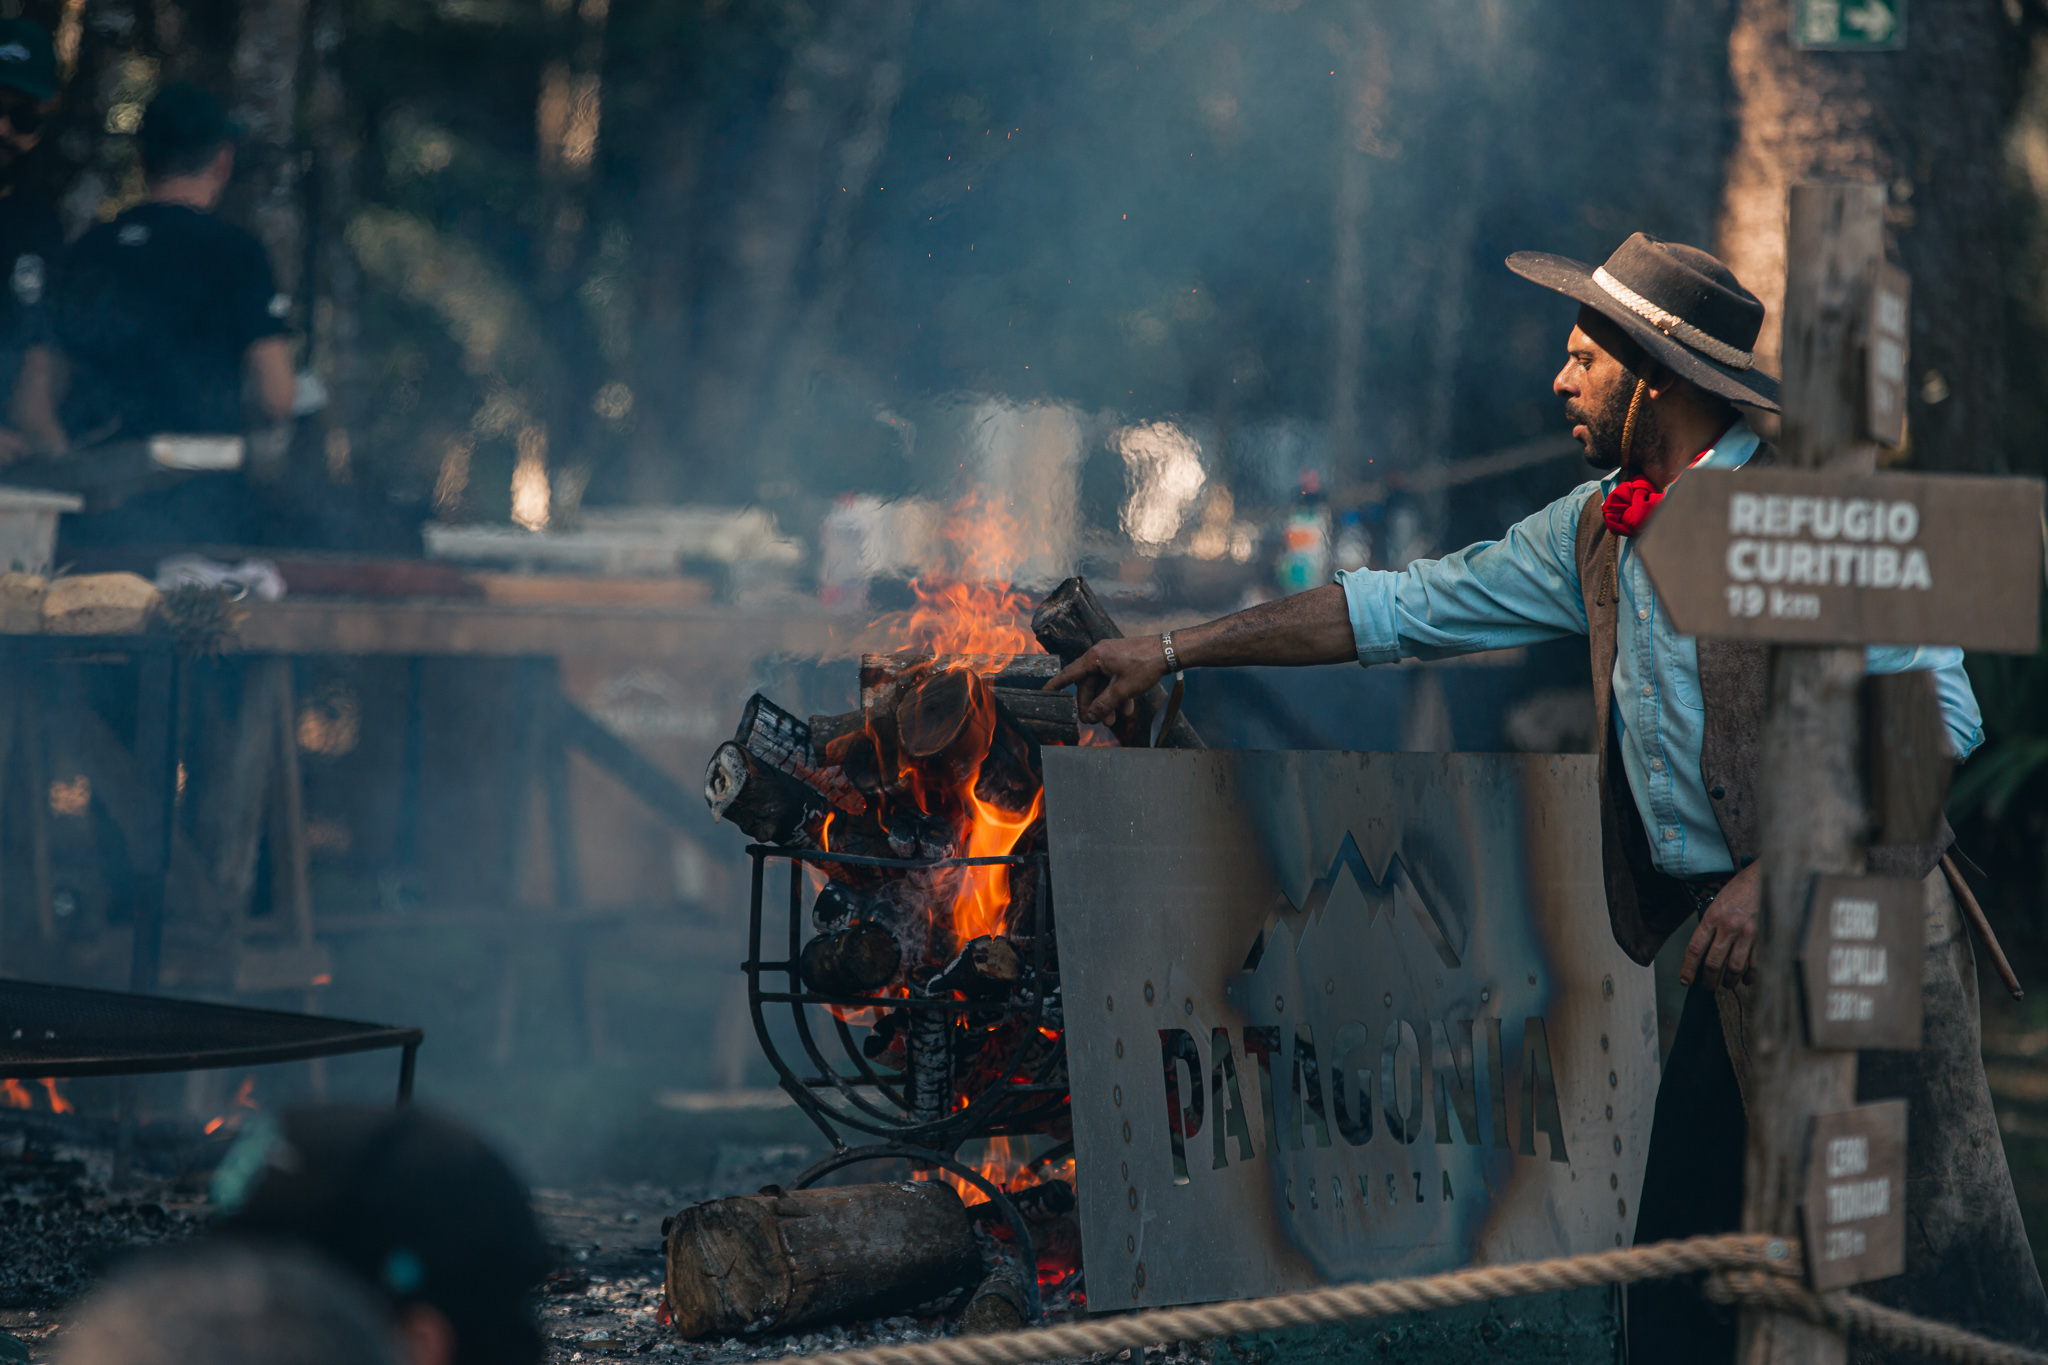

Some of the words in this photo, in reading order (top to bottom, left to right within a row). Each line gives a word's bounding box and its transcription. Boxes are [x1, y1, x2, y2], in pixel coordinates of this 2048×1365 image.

[1730, 494, 1918, 541] REFUGIO
[1728, 542, 1931, 588] CURITIBA
[1728, 587, 1764, 617] 19
[1770, 588, 1820, 620] km
[1158, 1016, 1570, 1187] PATAGONIA
[1285, 1170, 1455, 1212] CERVEZA
